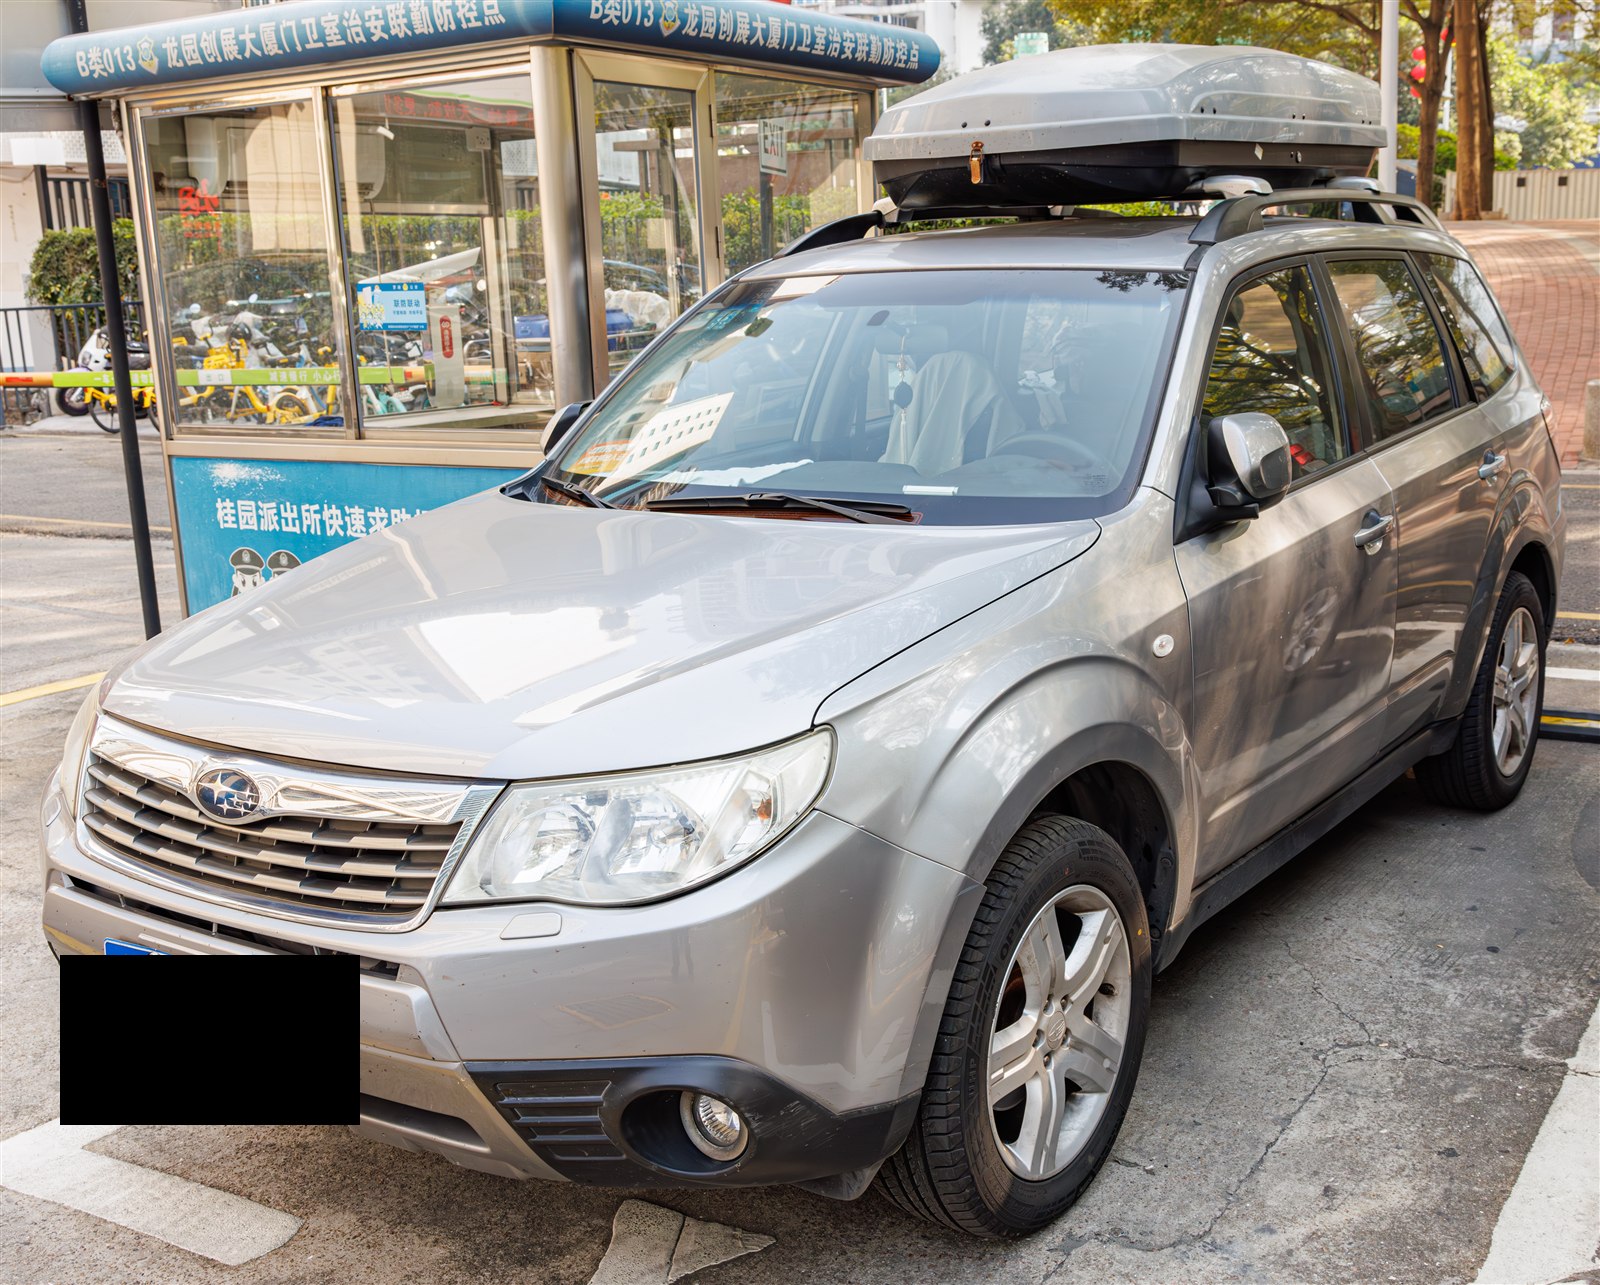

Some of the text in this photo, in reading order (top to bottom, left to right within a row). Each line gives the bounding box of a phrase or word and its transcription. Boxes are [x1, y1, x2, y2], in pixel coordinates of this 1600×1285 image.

[682, 3, 920, 70] 龙园创展大厦门卫室治安联勤防控点
[75, 45, 136, 79] B类013
[762, 120, 784, 158] EXIT
[215, 497, 429, 538] 桂园派出所快速求助
